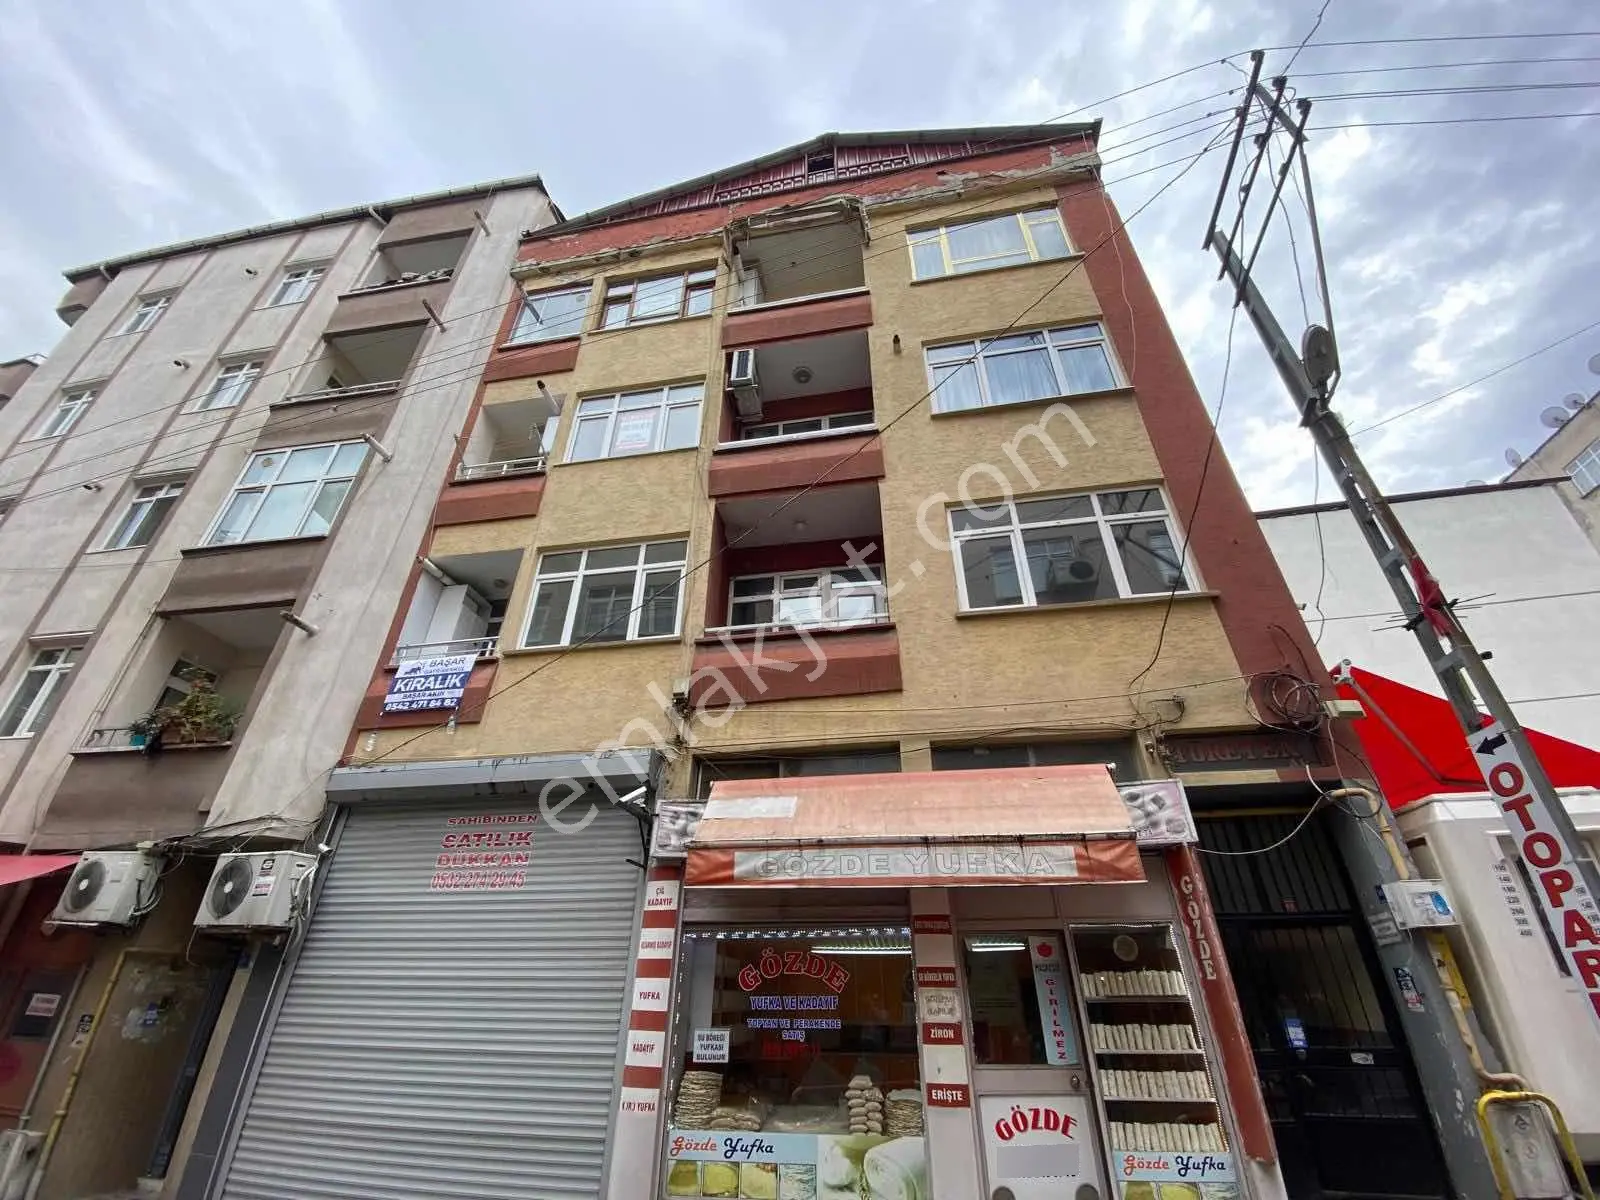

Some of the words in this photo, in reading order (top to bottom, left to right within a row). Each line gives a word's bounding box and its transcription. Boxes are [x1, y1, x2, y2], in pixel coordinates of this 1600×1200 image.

[442, 832, 534, 848] SATILIK
[437, 850, 530, 866] DÜKKAN
[757, 852, 891, 878] GÖZDE
[903, 851, 1056, 876] YUFKA
[1488, 762, 1600, 1020] OTOPAR
[647, 898, 673, 907] KADAYIF
[1181, 875, 1217, 980] GÖZDE
[738, 947, 850, 993] GÖZDE
[639, 991, 660, 1000] YUFKA
[750, 996, 782, 1010] YUFKA
[784, 996, 797, 1010] VE
[799, 996, 840, 1010] KADAYIF
[780, 1019, 791, 1029] VE
[794, 1019, 842, 1029] PERAKENDE
[782, 1030, 806, 1042] SATIŞ
[930, 1027, 954, 1039] ZİRON
[632, 1043, 656, 1054] KADAYIF
[931, 1087, 963, 1102] ERİŞTE
[637, 1101, 656, 1112] YUFKA
[995, 1105, 1078, 1140] GÖZDE
[670, 1136, 717, 1157] Gözde
[723, 1137, 775, 1159] Yufka
[1123, 1155, 1169, 1176] Gözde
[1175, 1156, 1226, 1177] Yufka
